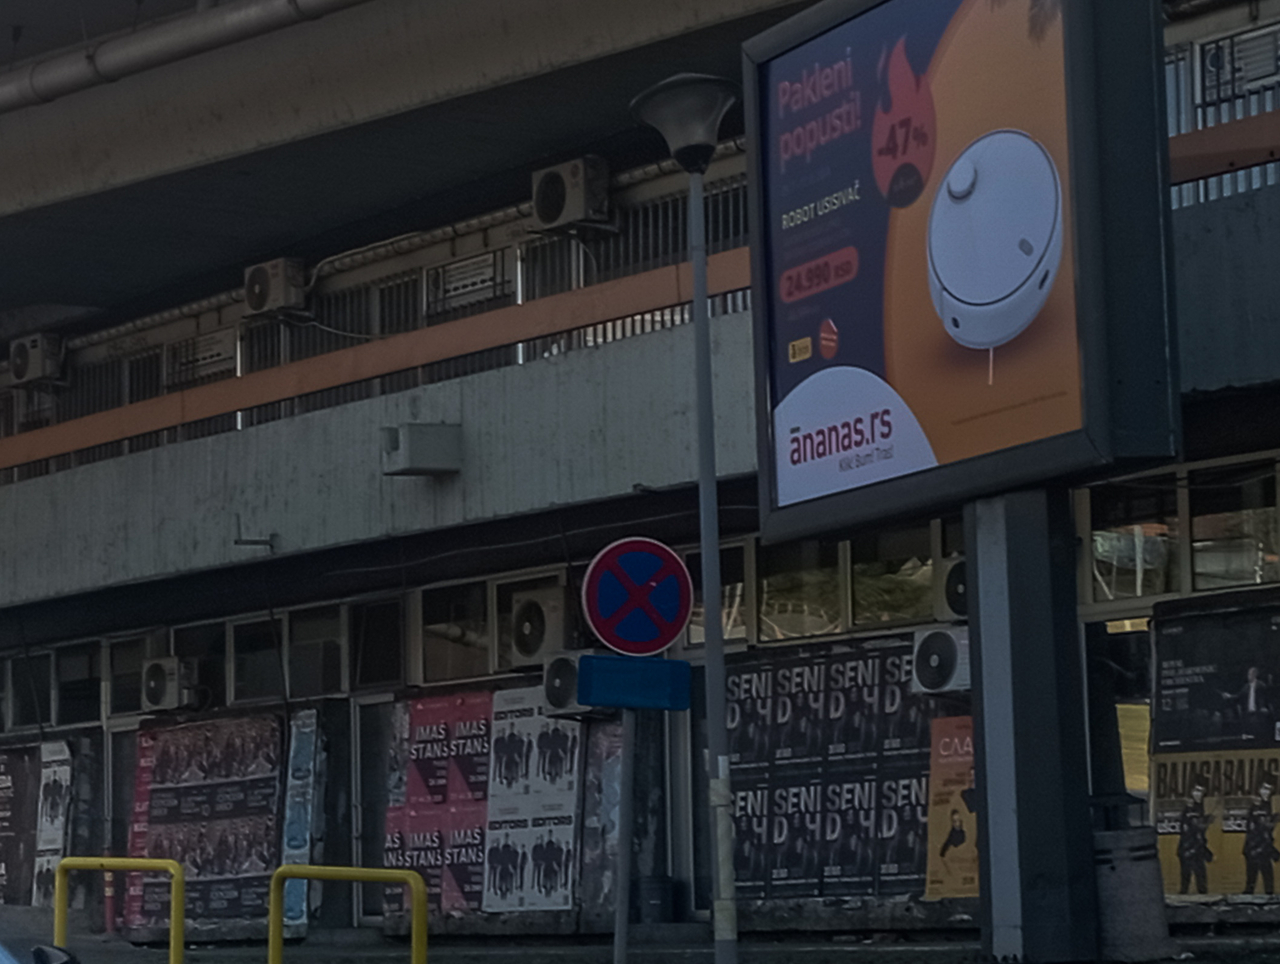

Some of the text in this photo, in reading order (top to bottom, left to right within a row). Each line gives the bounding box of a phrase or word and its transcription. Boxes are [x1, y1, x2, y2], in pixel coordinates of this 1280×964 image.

[778, 47, 854, 118] Pakleni
[779, 91, 862, 173] popusti!
[781, 202, 817, 229] ROBOT
[816, 179, 860, 215] USISIVAČ
[777, 665, 825, 695] SENI
[829, 658, 880, 689] SENI
[884, 655, 913, 683] SE
[727, 671, 773, 701] SENI
[773, 785, 821, 815] SENI
[826, 781, 876, 811] SENI
[881, 777, 927, 807] SEN
